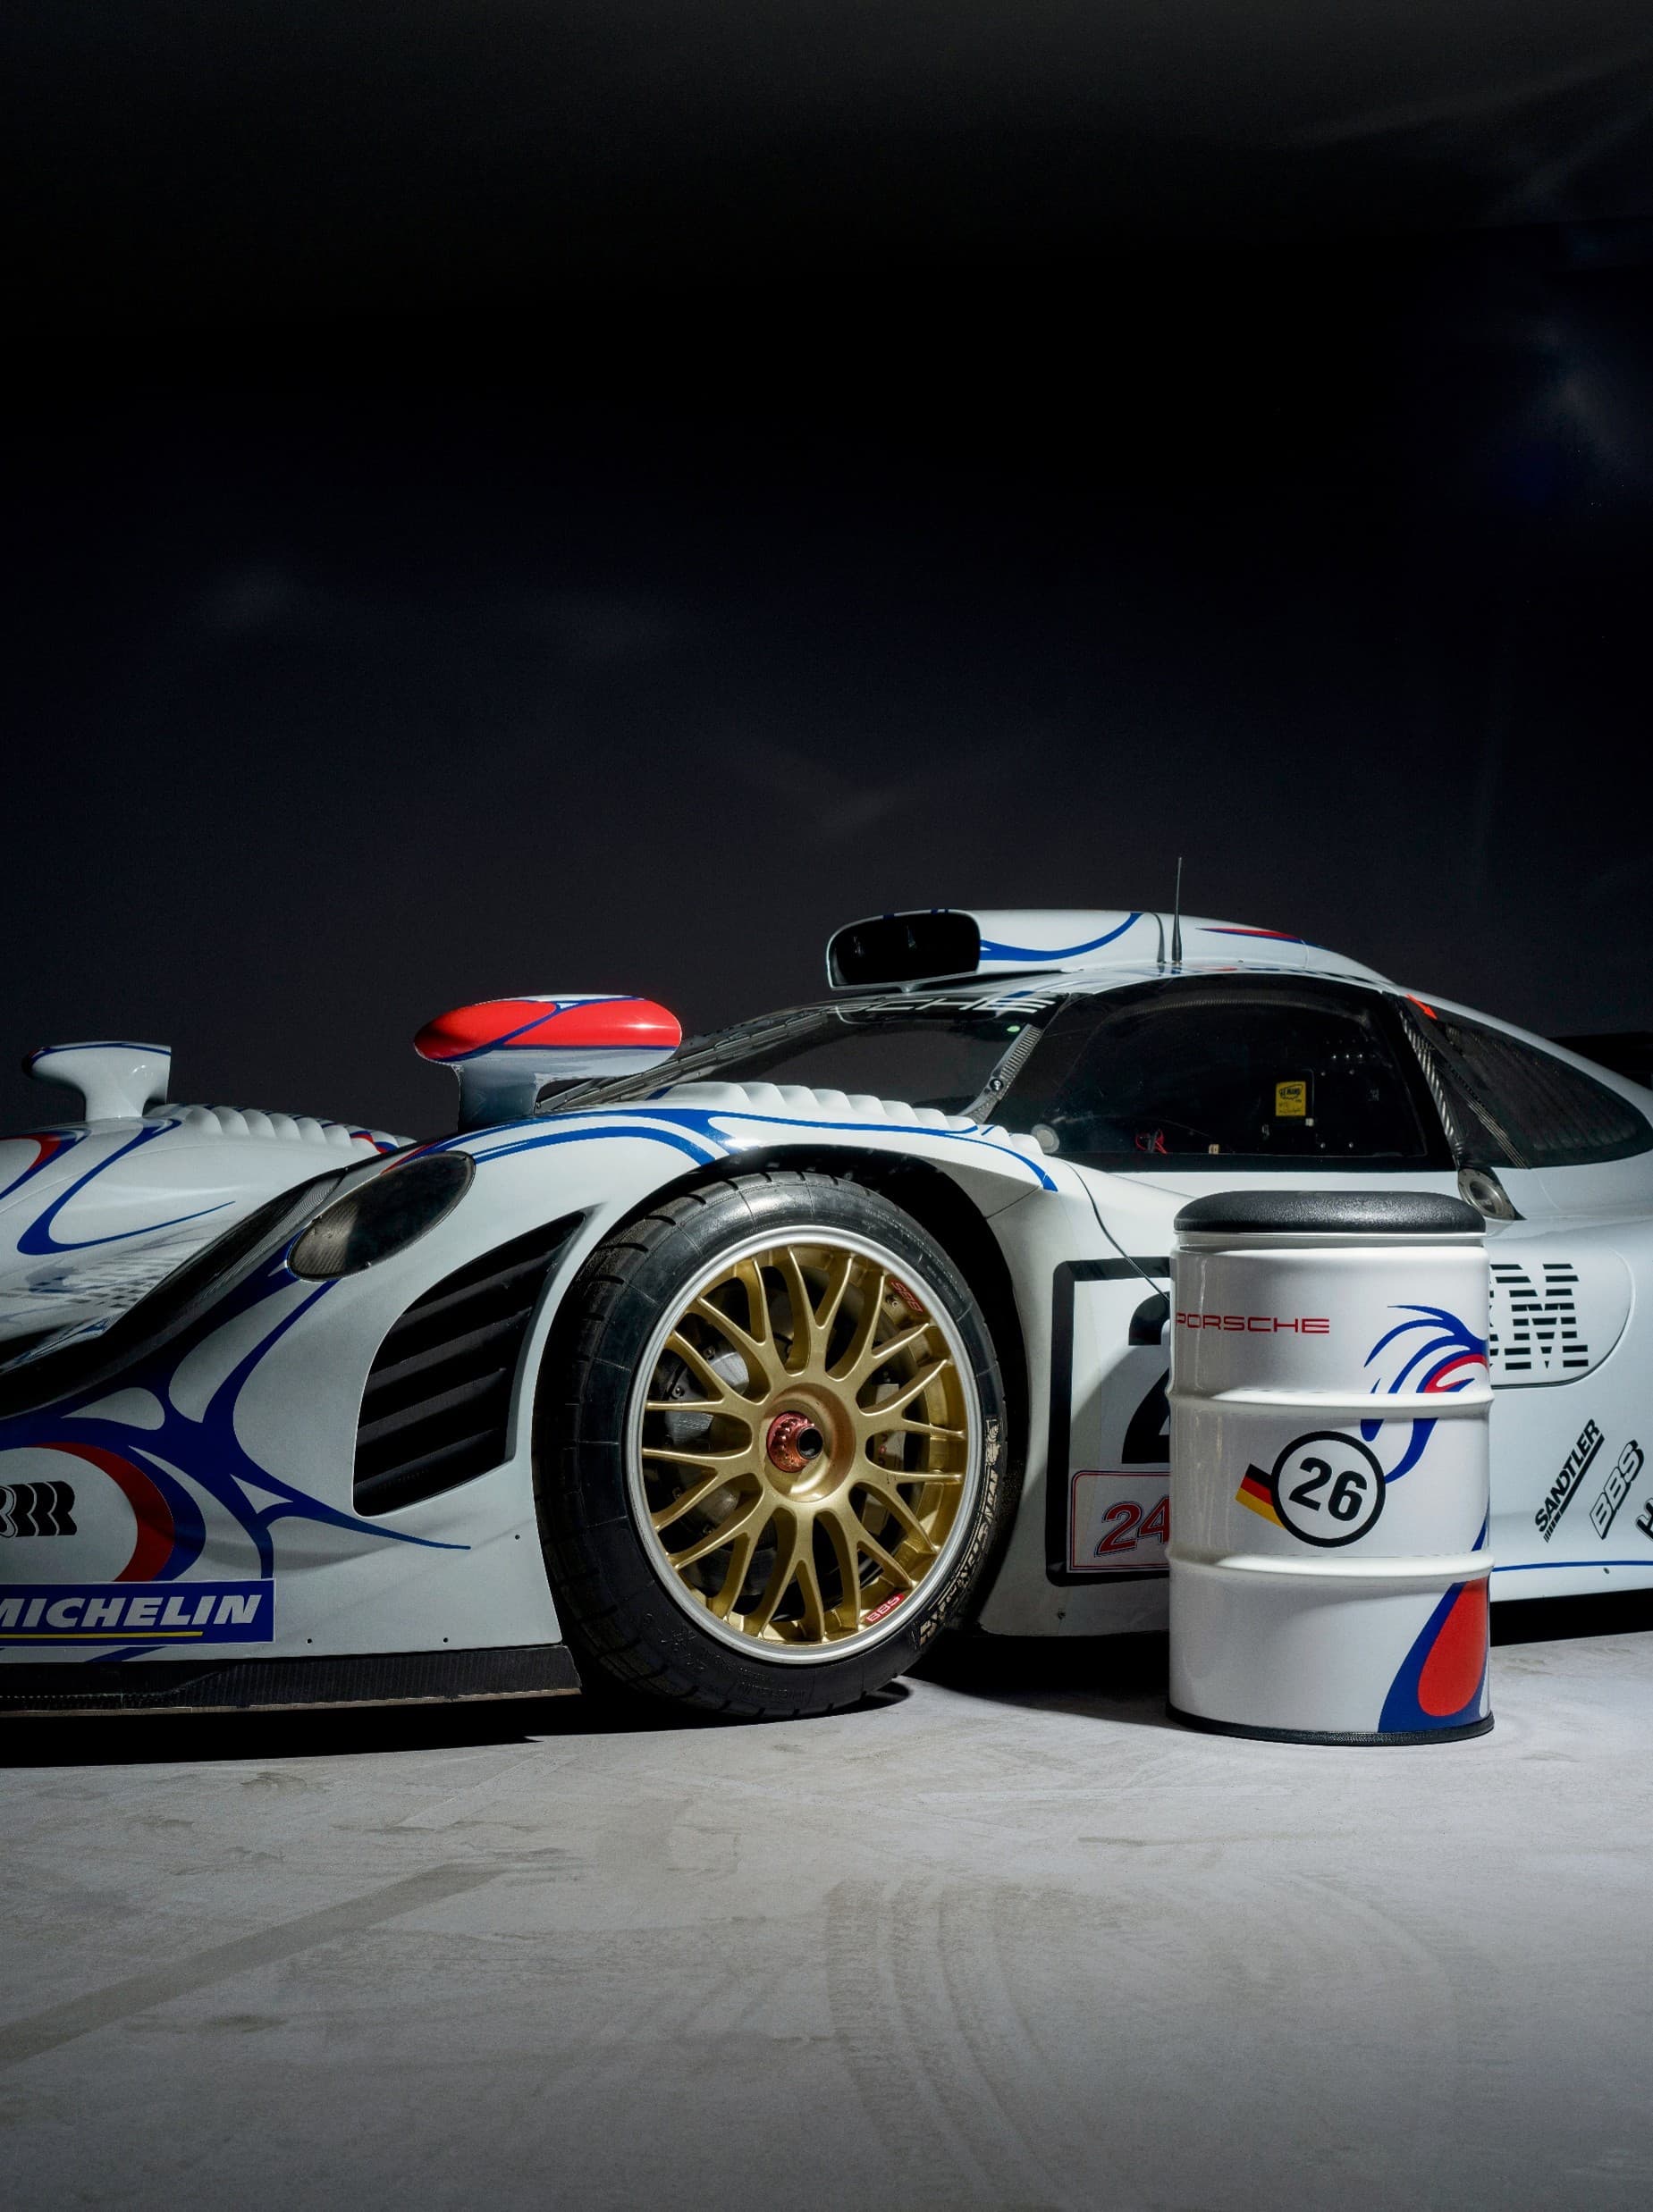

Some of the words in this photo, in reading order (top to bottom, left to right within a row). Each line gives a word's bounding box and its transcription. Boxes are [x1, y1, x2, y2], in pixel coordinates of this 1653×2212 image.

[1176, 1312, 1329, 1333] PORSCHE
[1288, 1456, 1368, 1521] 26
[1535, 1418, 1600, 1533] SANDTLER
[1590, 1439, 1644, 1540] BBS
[865, 1596, 900, 1622] BBS
